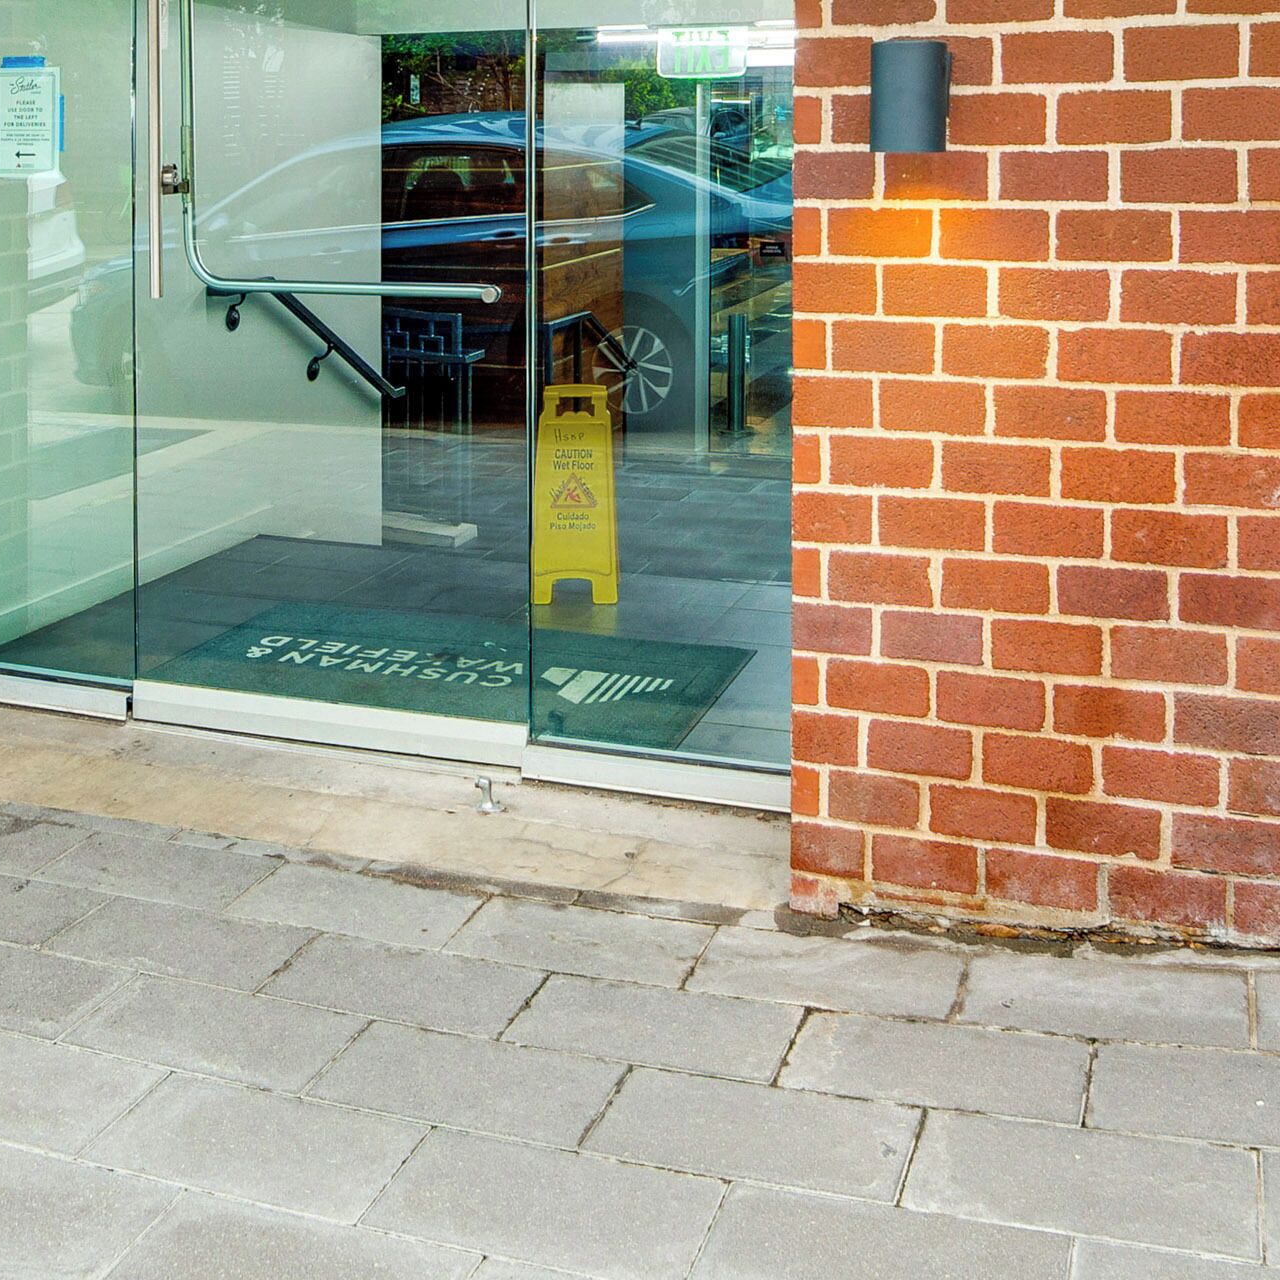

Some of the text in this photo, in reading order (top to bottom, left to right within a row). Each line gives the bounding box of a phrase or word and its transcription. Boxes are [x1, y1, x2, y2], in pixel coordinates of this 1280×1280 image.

[554, 448, 592, 459] CAUTION
[552, 460, 594, 470] Wet Floor
[556, 512, 590, 521] Cuidado
[550, 521, 596, 532] Piso Mojado
[246, 646, 513, 688] CUSHMAN &
